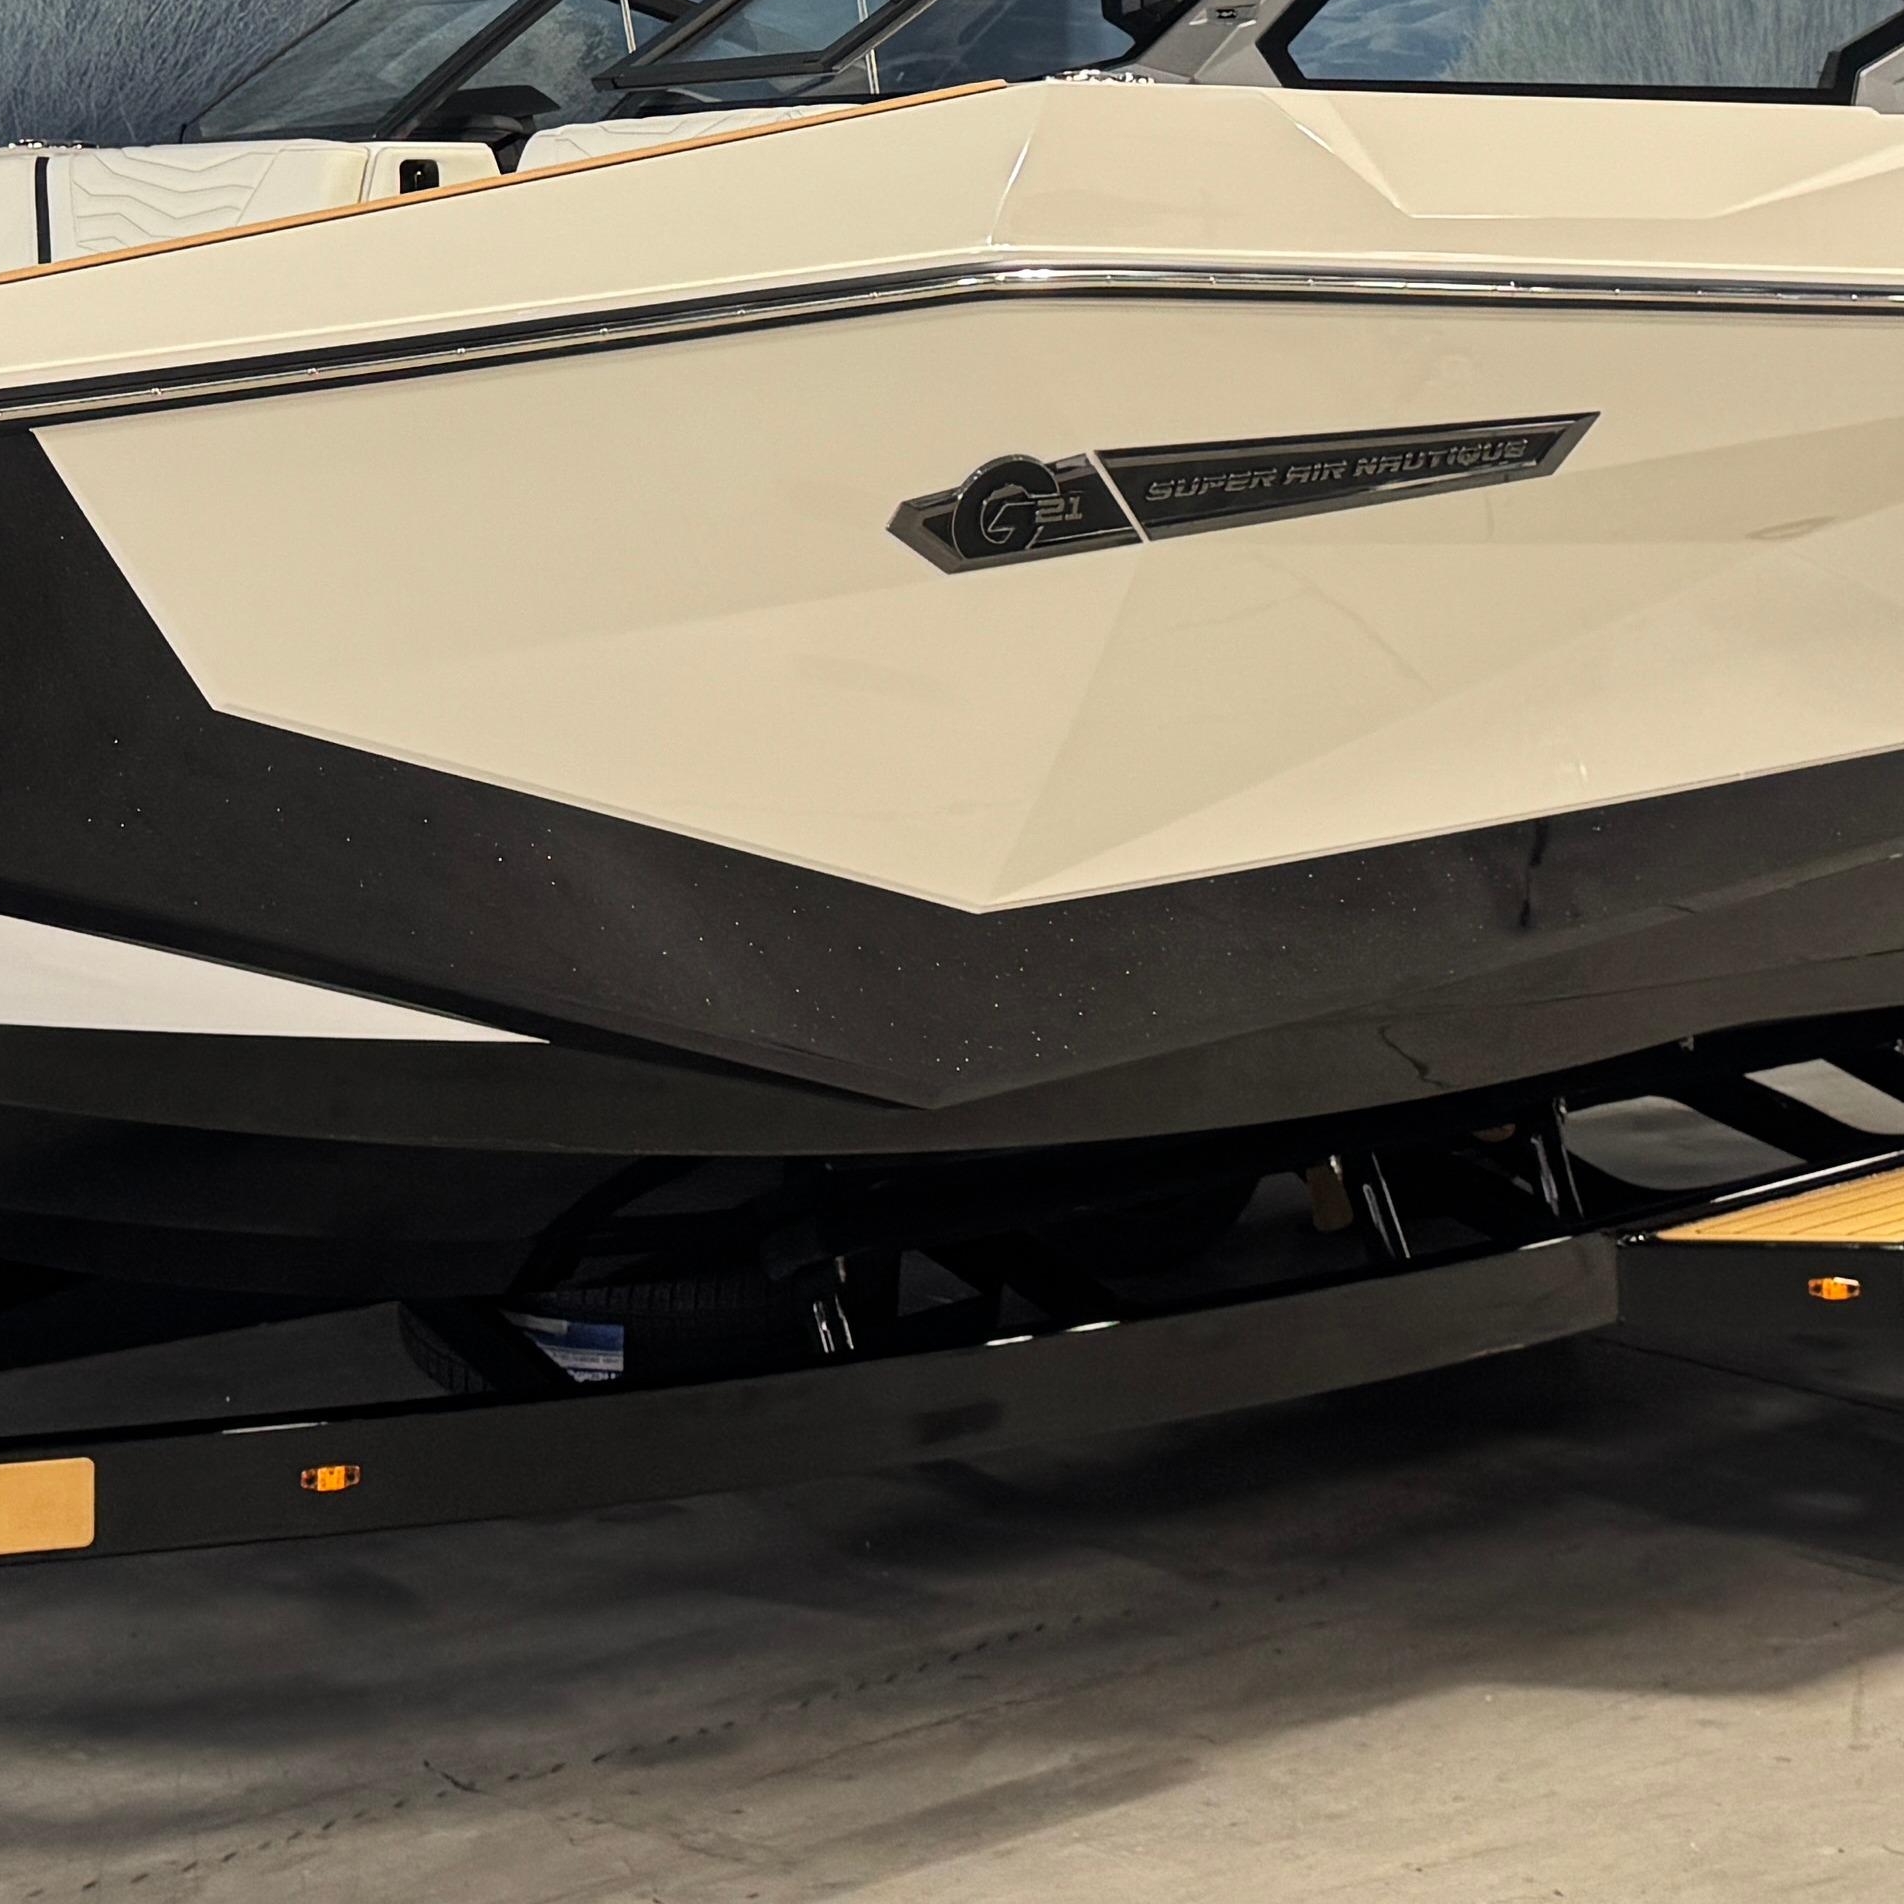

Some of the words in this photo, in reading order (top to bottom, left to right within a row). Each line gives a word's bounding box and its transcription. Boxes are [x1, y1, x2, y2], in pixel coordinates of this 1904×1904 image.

[1145, 467, 1278, 502] SUPER
[1283, 460, 1347, 485] AIR
[1353, 439, 1528, 478] NAUTIQUE
